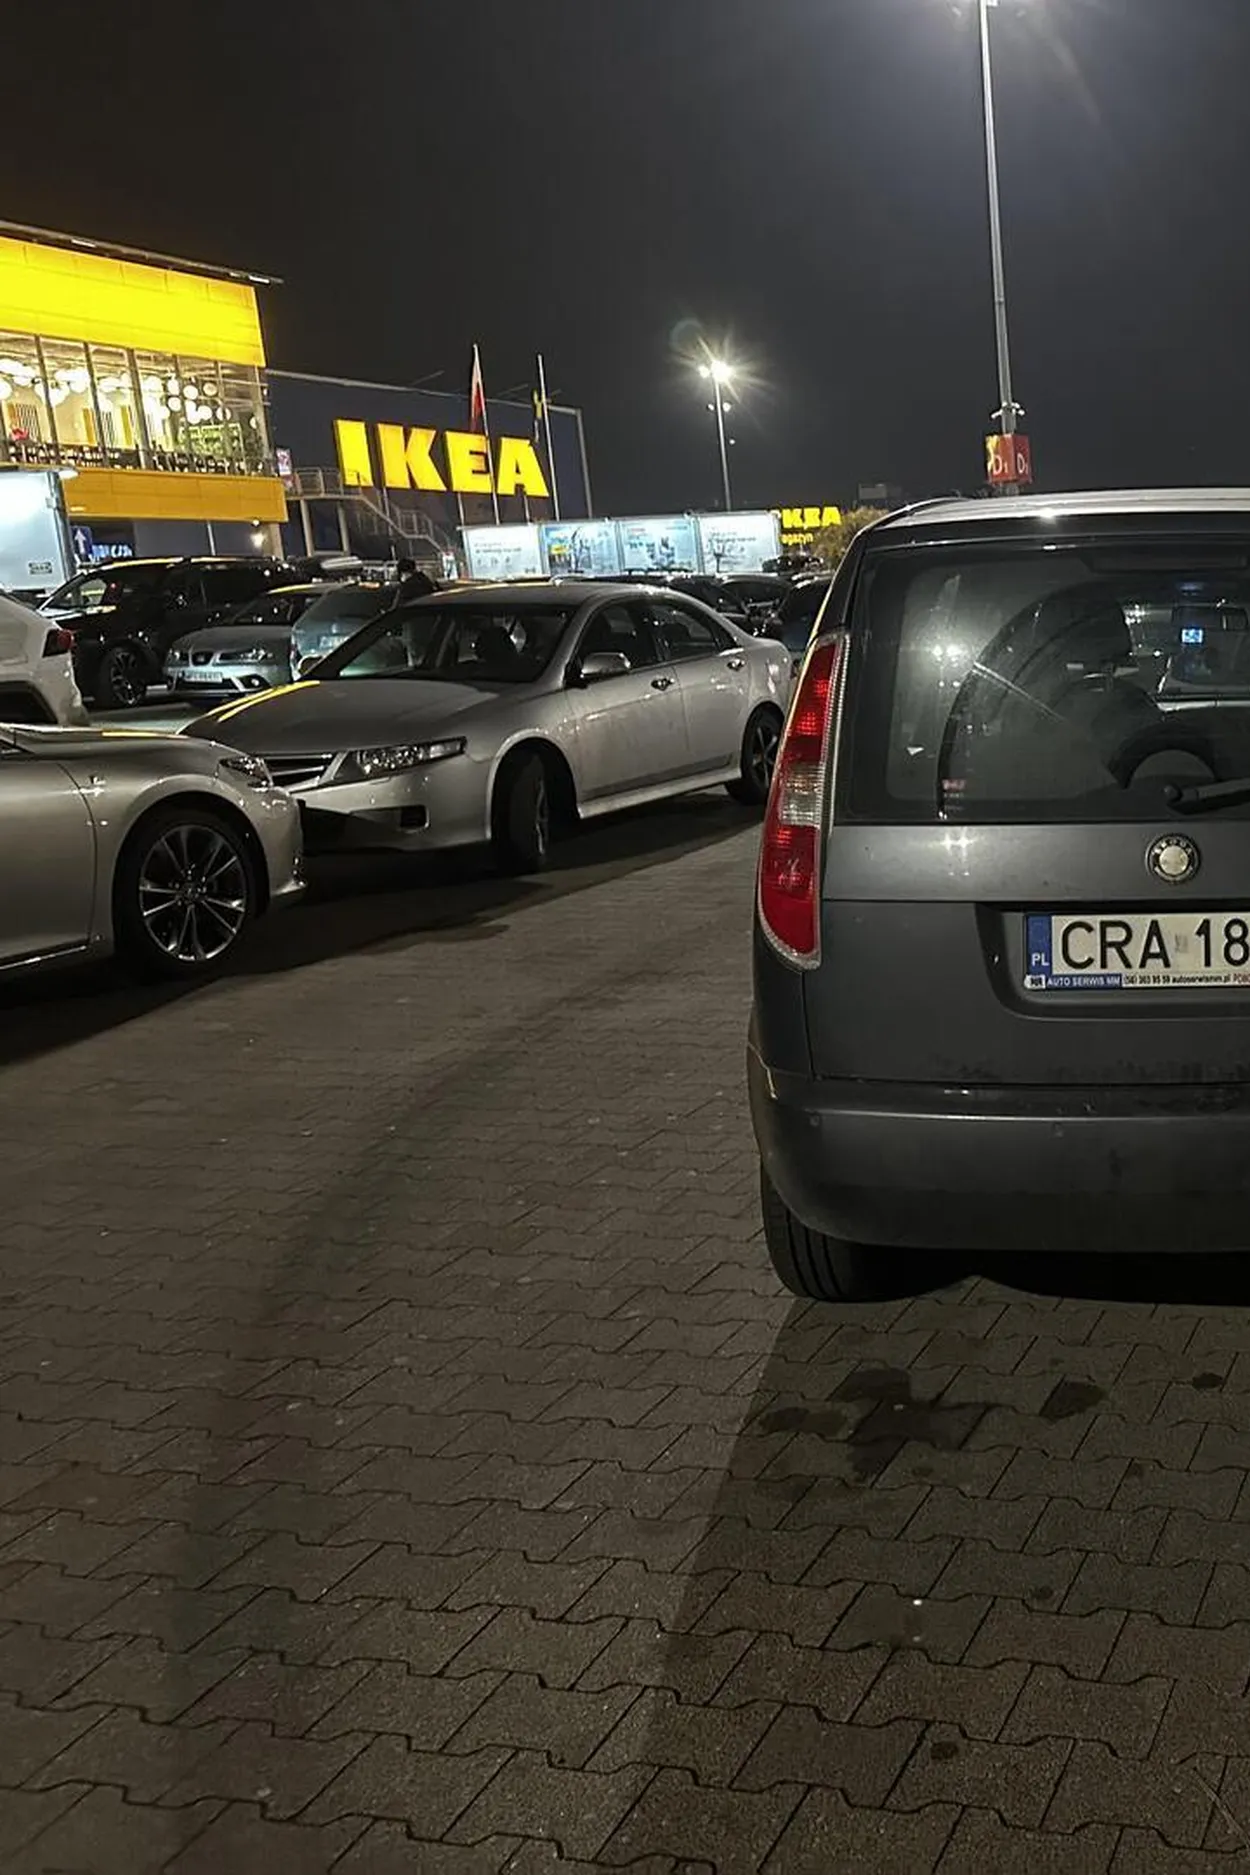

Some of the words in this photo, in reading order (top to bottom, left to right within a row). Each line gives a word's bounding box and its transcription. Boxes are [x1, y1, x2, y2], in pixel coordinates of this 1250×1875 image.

[336, 419, 549, 497] IKEA
[781, 506, 842, 529] KEA
[1061, 919, 1171, 970] CRA
[1031, 952, 1050, 967] PL
[1047, 975, 1071, 987] AUTO
